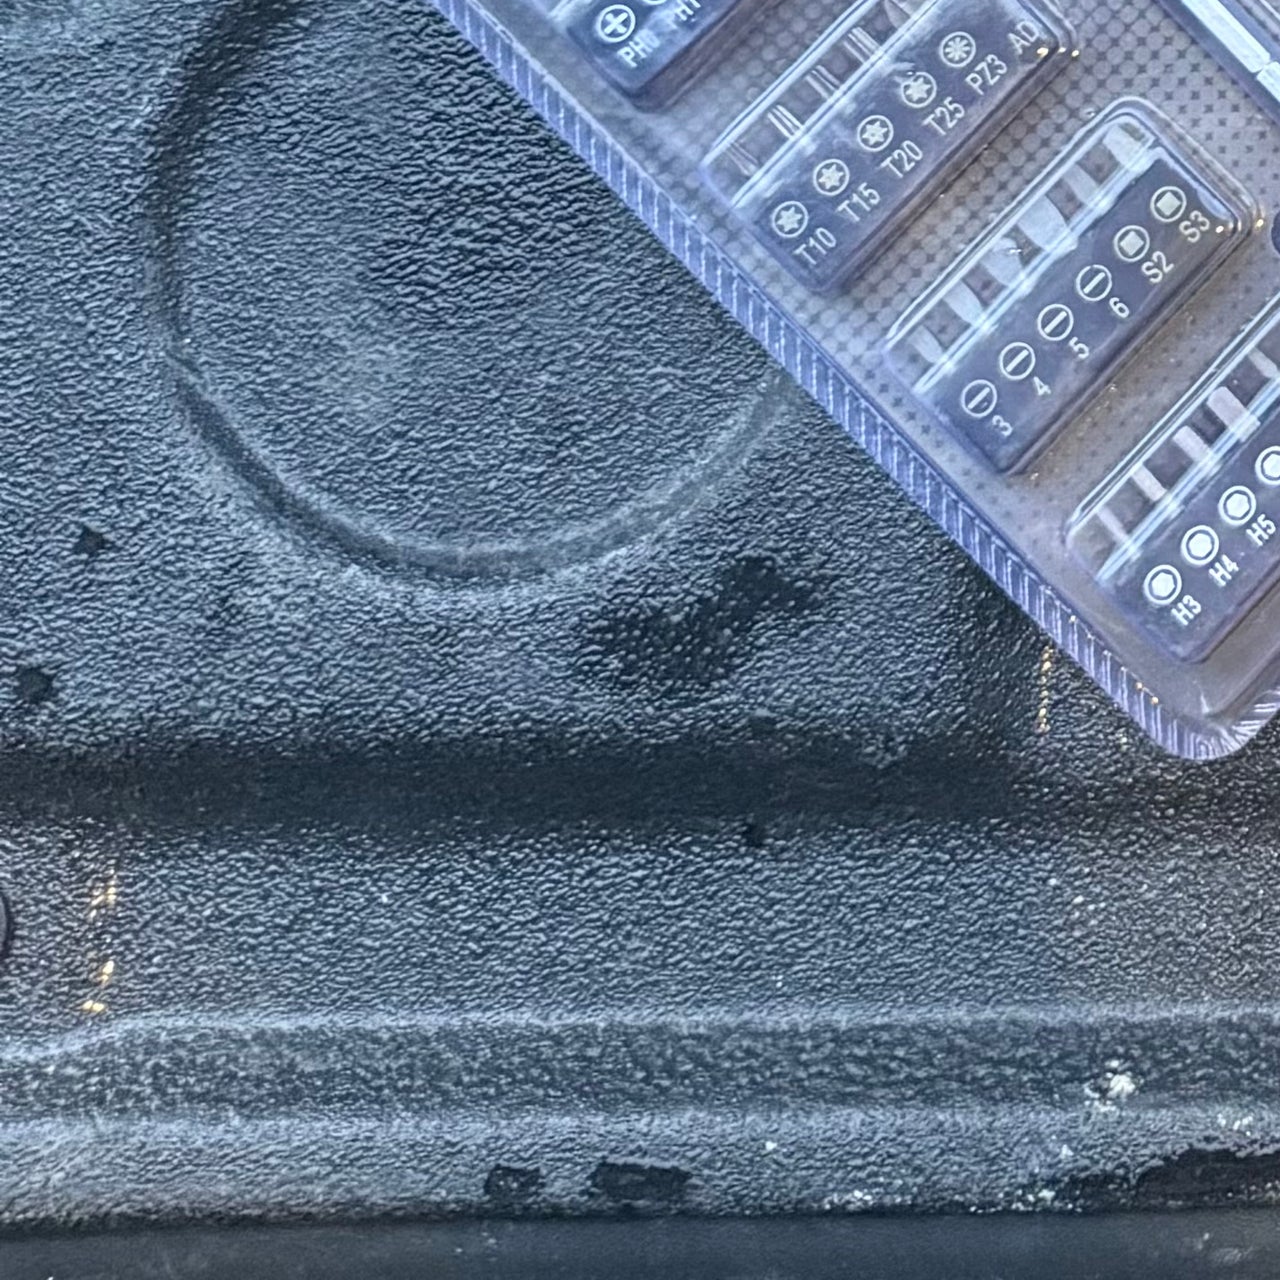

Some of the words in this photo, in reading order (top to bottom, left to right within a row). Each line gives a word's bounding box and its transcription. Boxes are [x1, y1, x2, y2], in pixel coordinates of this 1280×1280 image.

[792, 226, 838, 267] T10
[835, 181, 881, 224] T15
[880, 139, 925, 180] T20
[922, 96, 966, 137] T25
[964, 53, 1009, 96] PZ3
[1007, 18, 1041, 56] AD
[991, 414, 1014, 438] 3
[1031, 375, 1052, 397] 4
[1068, 336, 1091, 361] 5
[1108, 296, 1131, 320] 6
[1140, 250, 1176, 286] S2
[1177, 209, 1212, 244] S3
[1170, 592, 1203, 626] H3
[1207, 553, 1241, 588] H4
[1244, 513, 1278, 547] H5
